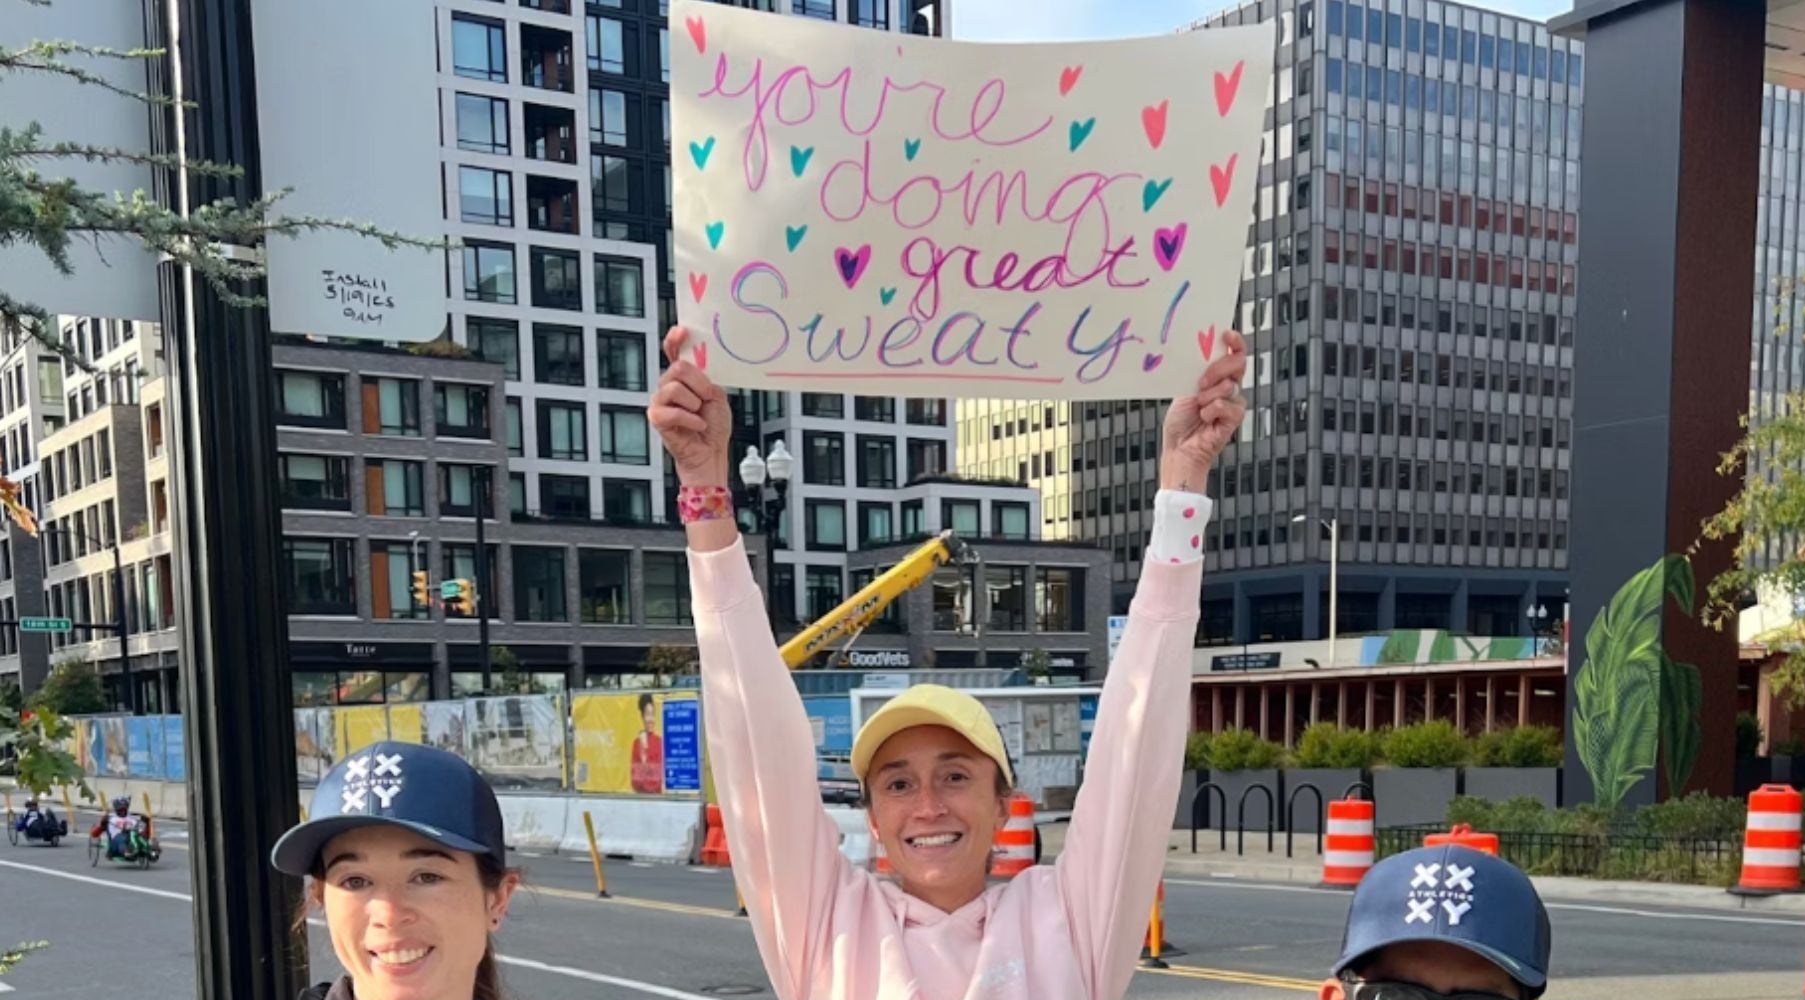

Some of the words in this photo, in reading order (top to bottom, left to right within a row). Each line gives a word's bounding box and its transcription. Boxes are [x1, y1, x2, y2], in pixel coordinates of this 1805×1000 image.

[699, 47, 1053, 192] you're
[820, 139, 1143, 272] doing
[901, 236, 1150, 321] great
[850, 652, 911, 666] GoodVets
[344, 753, 403, 782] XX
[341, 785, 401, 813] XY
[1411, 863, 1475, 891] XX
[1405, 898, 1472, 925] XY
